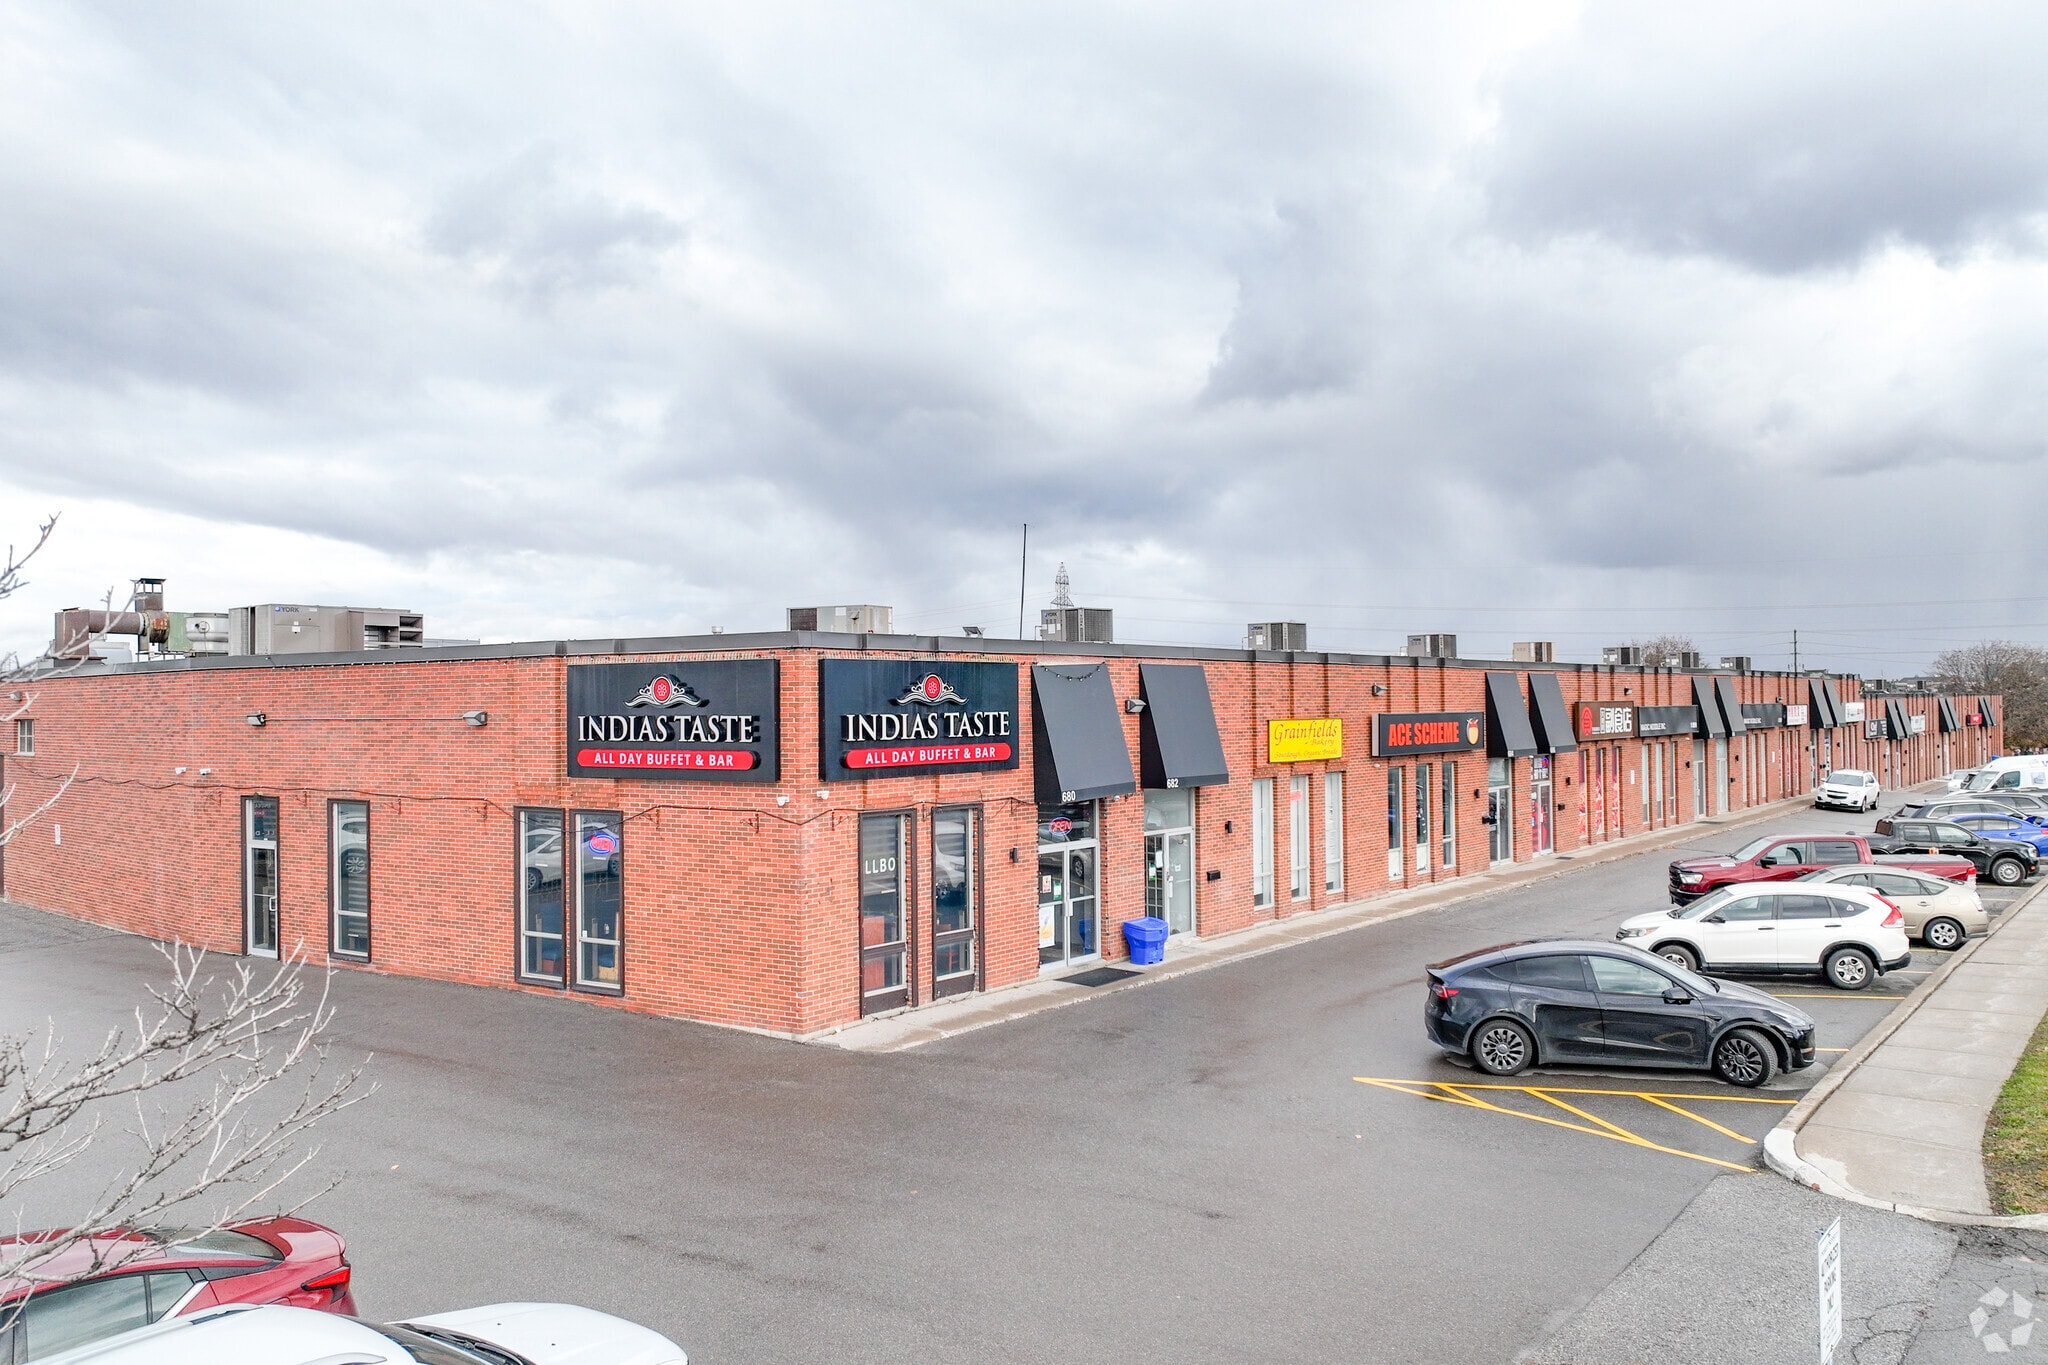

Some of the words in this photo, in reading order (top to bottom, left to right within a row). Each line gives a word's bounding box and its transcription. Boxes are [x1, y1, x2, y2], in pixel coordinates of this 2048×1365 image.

[578, 715, 668, 742] INDIAS
[674, 715, 753, 743] TASTE
[846, 712, 938, 742] INDIAS
[944, 711, 1010, 738] TASTE
[1274, 720, 1338, 746] Grainfields
[1388, 723, 1412, 746] ACE
[1413, 721, 1460, 745] SCHEME
[594, 752, 615, 764] ALL
[619, 753, 642, 765] DAY
[647, 753, 691, 766] BUFFET
[695, 755, 704, 766] &
[709, 754, 734, 767] BAR
[865, 752, 887, 765] ALL
[892, 750, 915, 763] DAY
[919, 748, 960, 761] BUFFET
[963, 748, 971, 759] &
[975, 747, 996, 758] BAR
[1166, 778, 1179, 789] 682
[1062, 790, 1076, 802] 680
[1050, 819, 1073, 834] OPEN
[865, 857, 896, 875] LLBO
